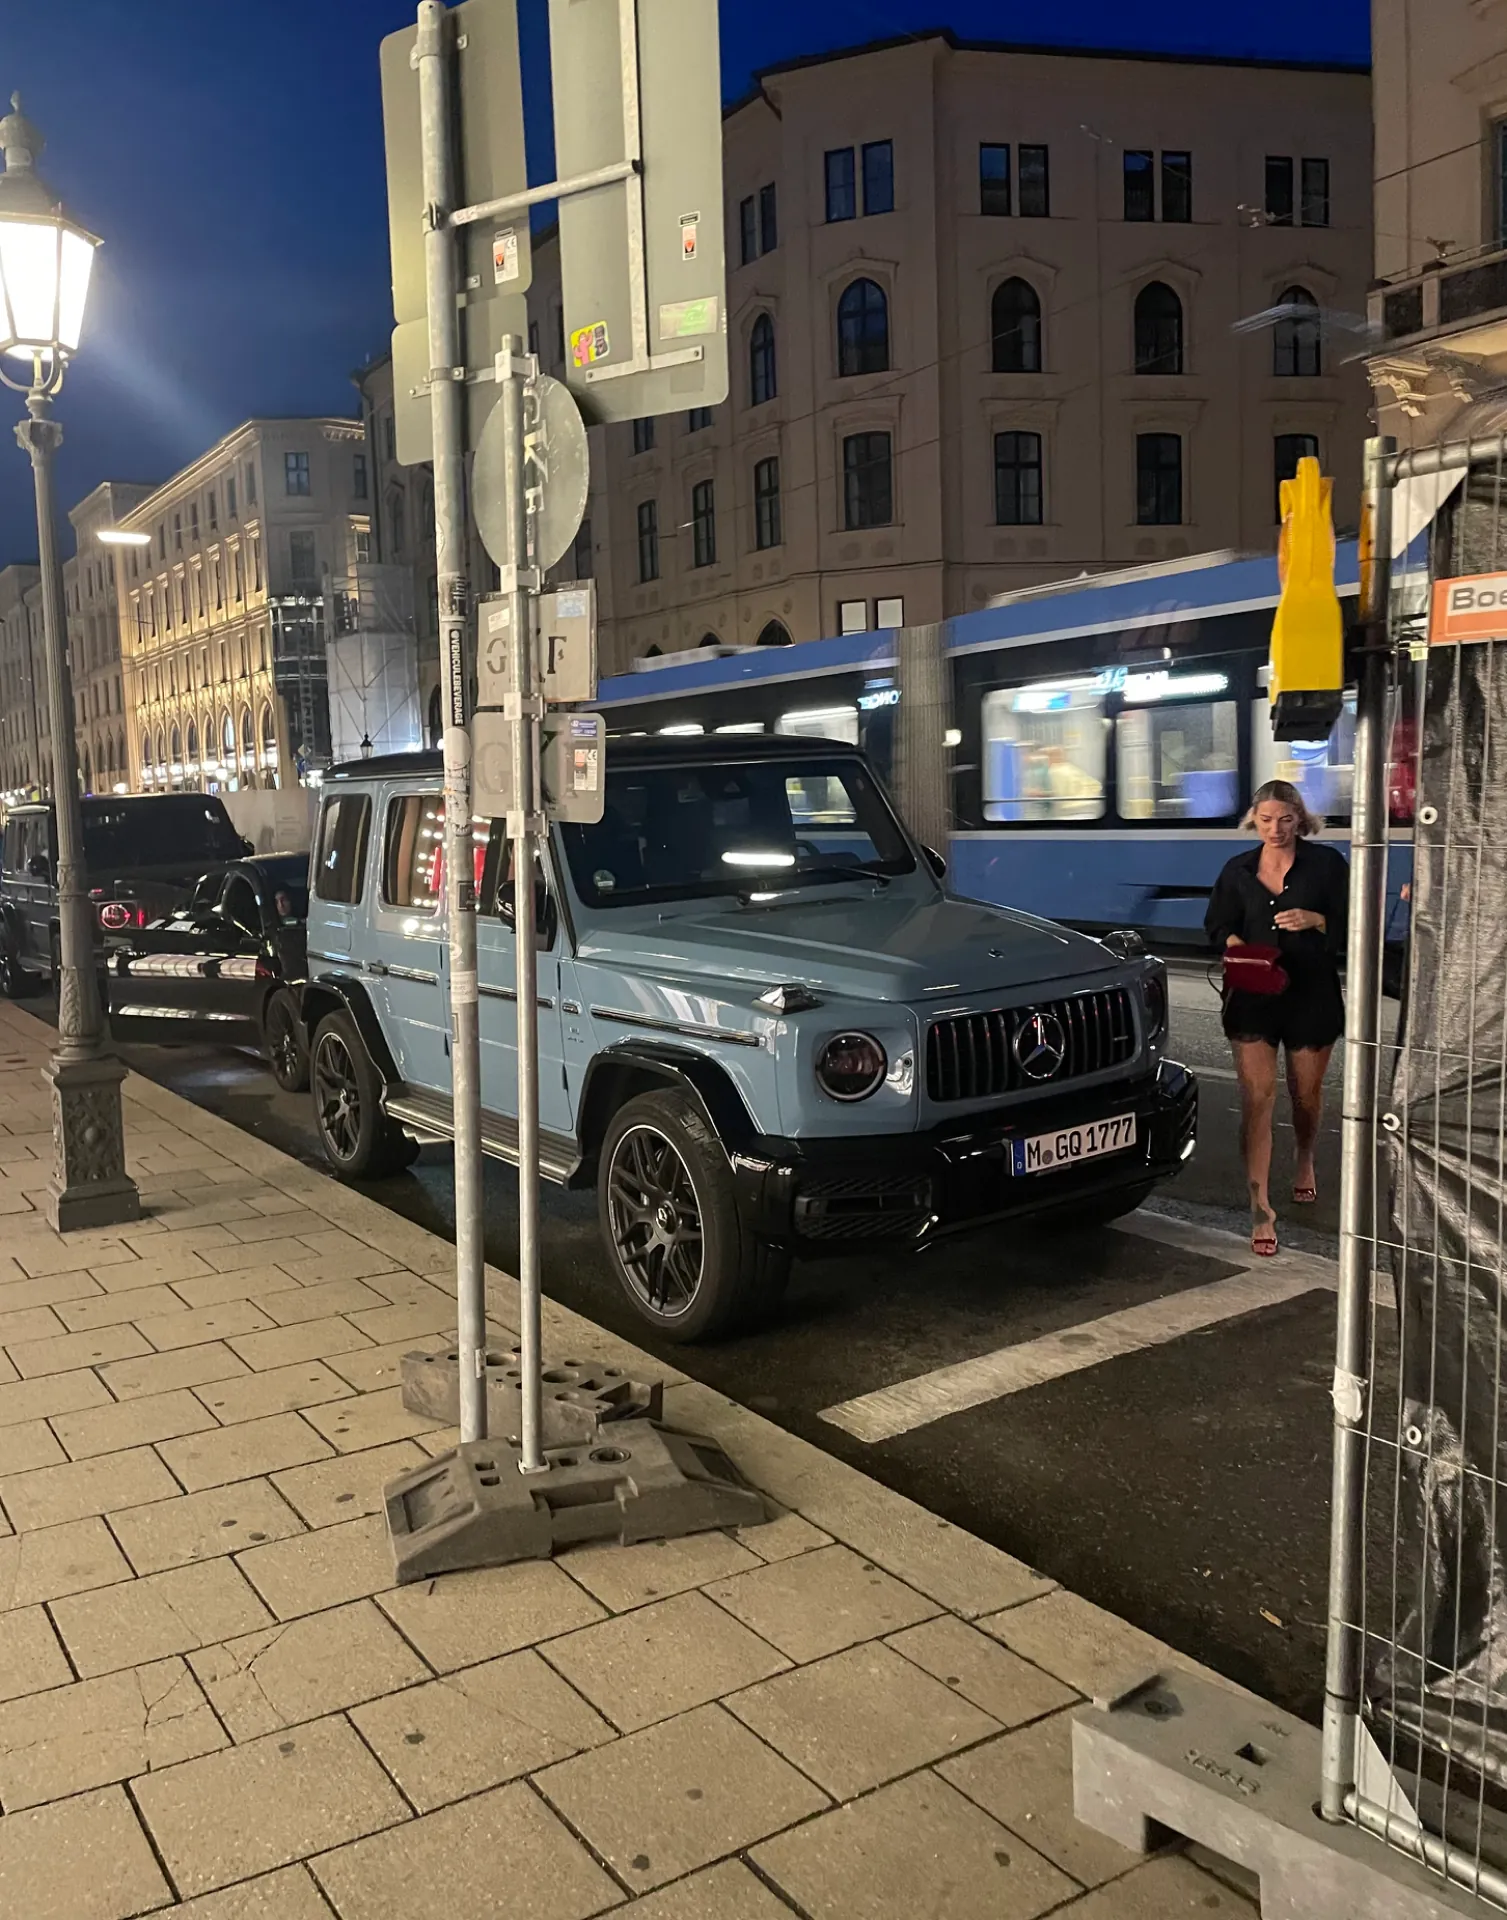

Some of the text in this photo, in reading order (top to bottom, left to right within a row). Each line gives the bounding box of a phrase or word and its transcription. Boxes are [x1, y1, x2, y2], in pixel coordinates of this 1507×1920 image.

[1027, 1117, 1132, 1168] M GQ 1777
